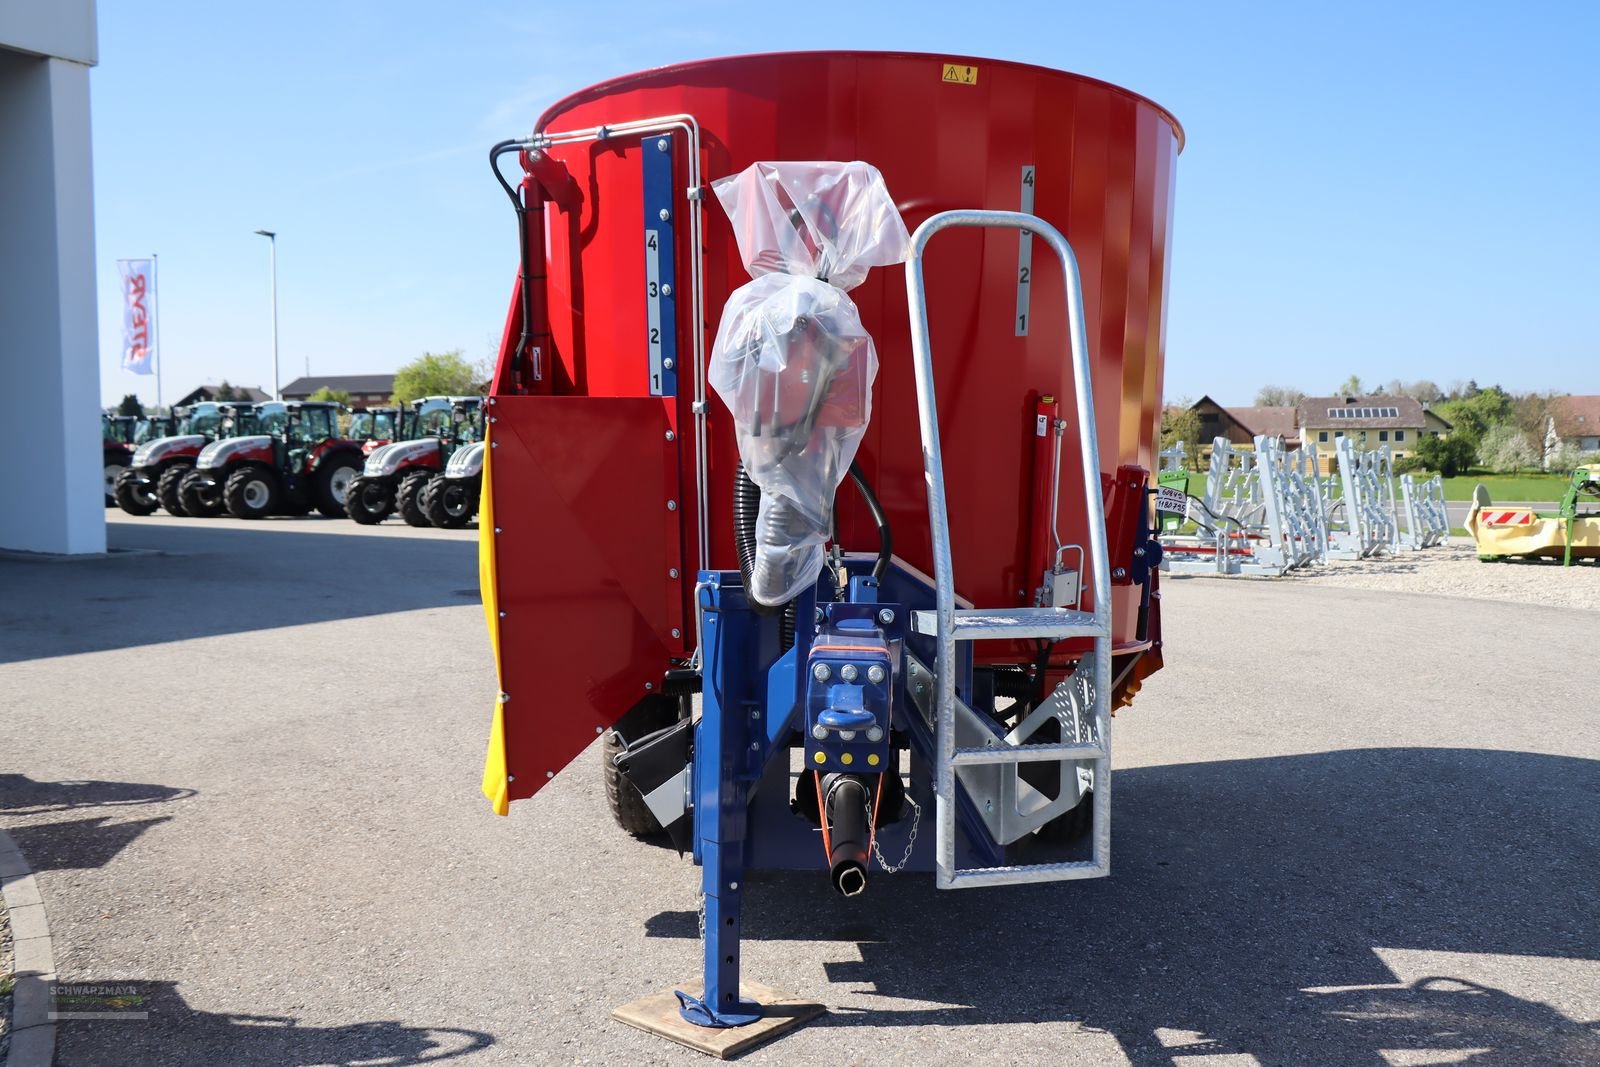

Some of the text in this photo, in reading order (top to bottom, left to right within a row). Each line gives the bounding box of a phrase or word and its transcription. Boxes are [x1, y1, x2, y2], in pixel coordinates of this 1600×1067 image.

[1023, 170, 1033, 188] 4
[647, 234, 657, 251] 4
[1020, 268, 1029, 284] 2
[649, 281, 658, 298] 3
[1019, 314, 1026, 331] 1
[650, 328, 660, 344] 2
[652, 373, 660, 390] 1
